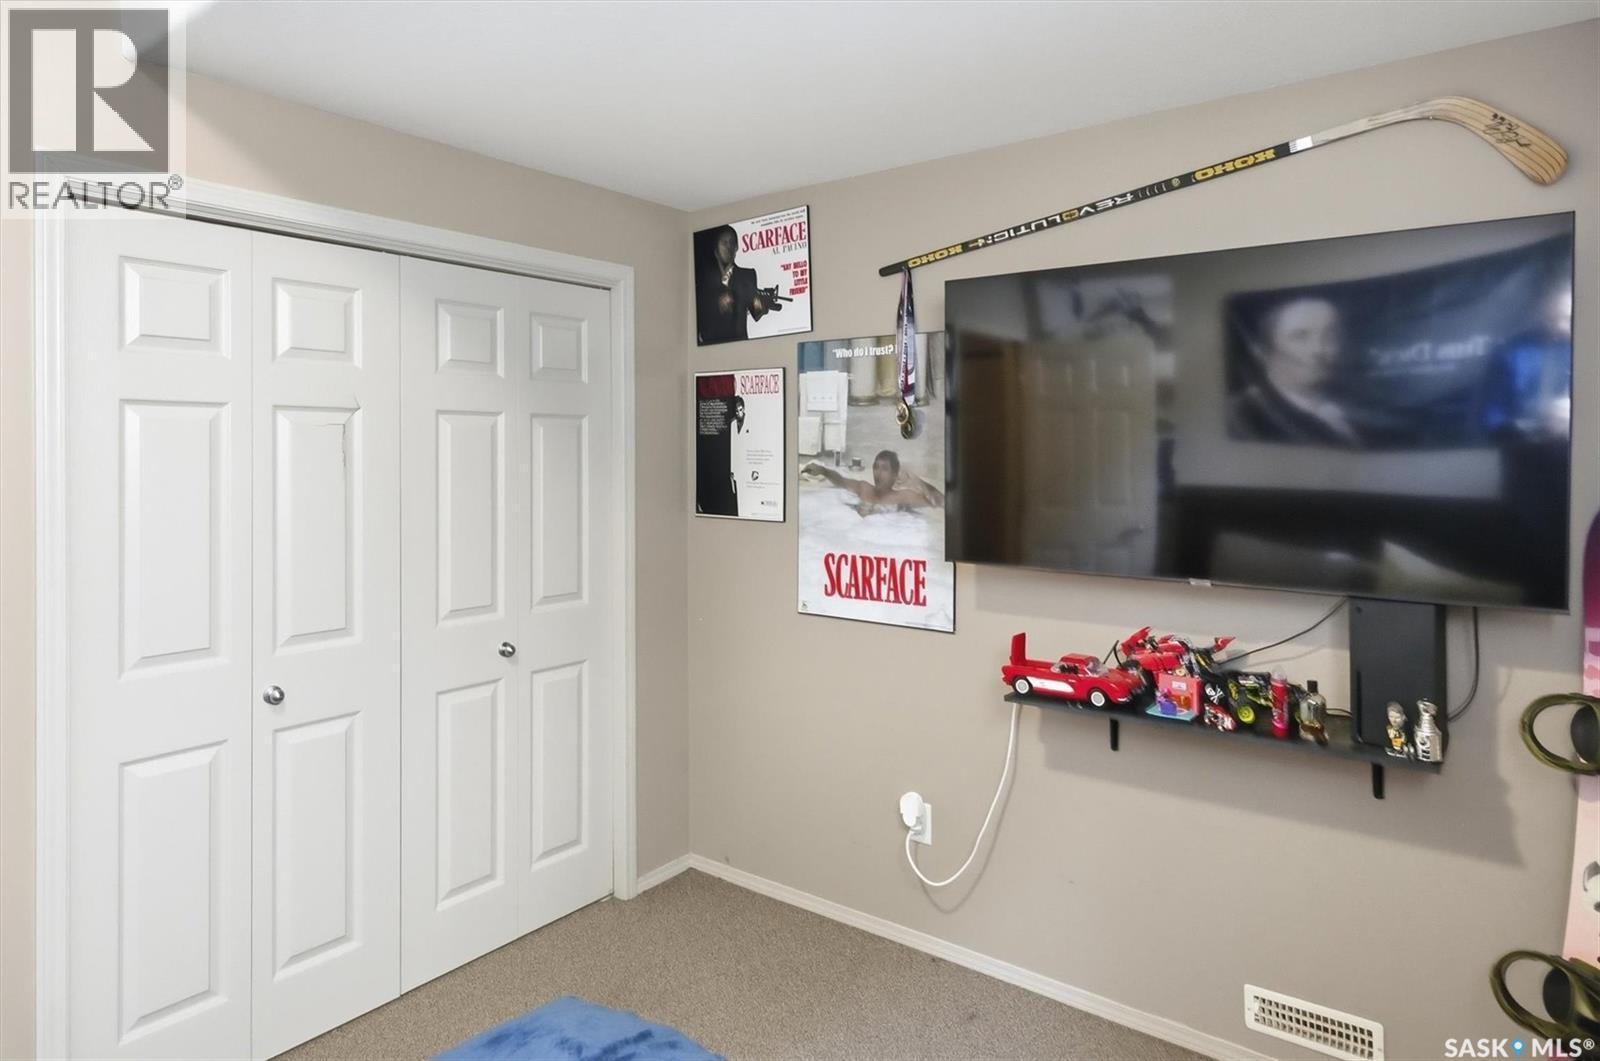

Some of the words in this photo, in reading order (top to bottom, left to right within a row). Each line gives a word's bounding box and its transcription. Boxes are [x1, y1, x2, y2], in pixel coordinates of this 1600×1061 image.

[1194, 148, 1276, 181] KOHO
[742, 222, 806, 252] SCARFACE
[907, 245, 963, 269] KOHO
[854, 347, 864, 357] do
[865, 346, 868, 356] I
[869, 344, 894, 356] trust?
[740, 374, 780, 395] SCARFACE
[824, 553, 927, 606] SCARFACE
